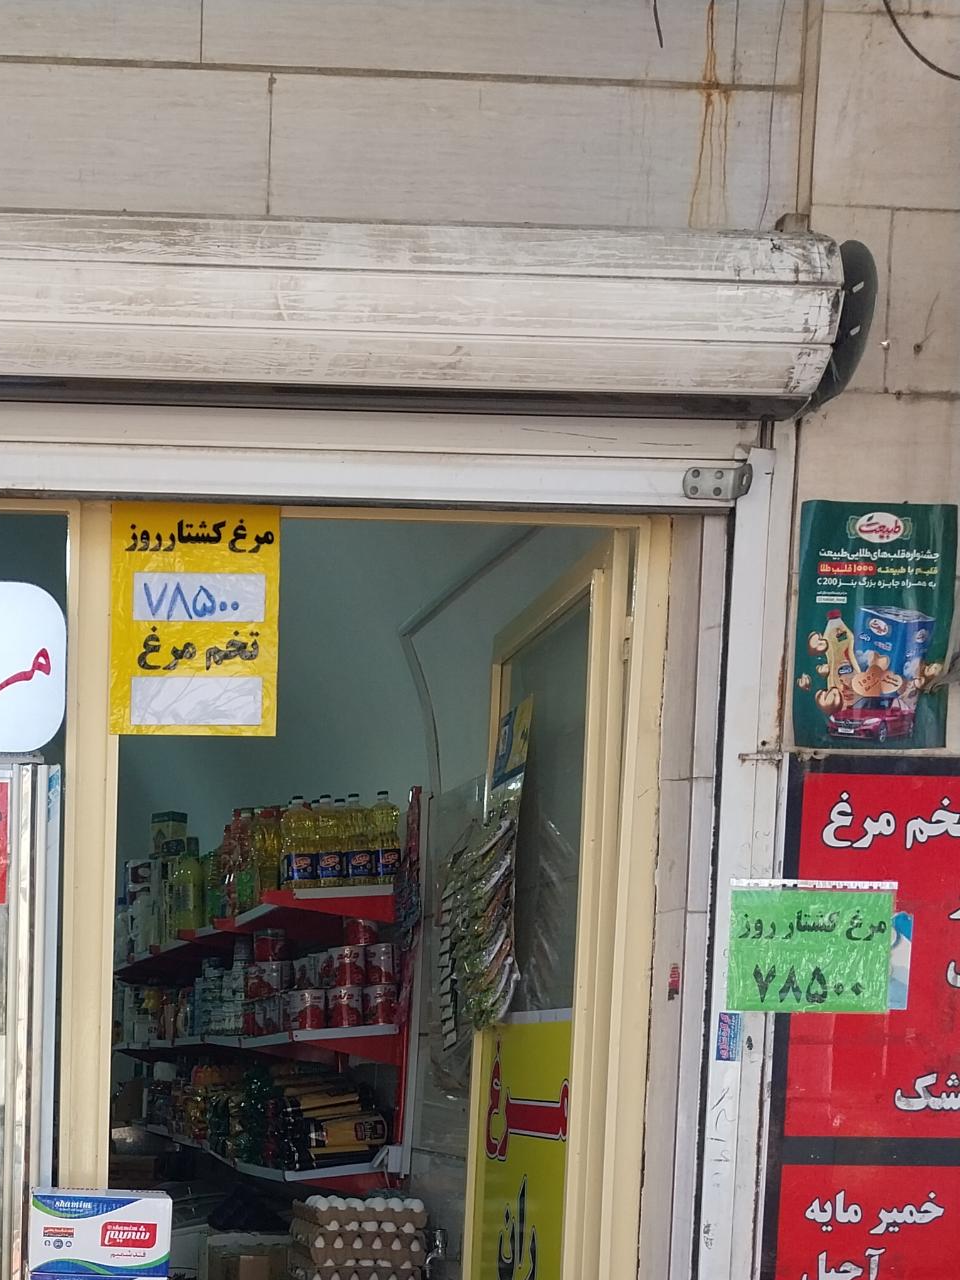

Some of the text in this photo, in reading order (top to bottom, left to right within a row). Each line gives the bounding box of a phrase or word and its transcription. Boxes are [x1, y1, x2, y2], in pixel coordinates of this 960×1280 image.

[125, 519, 274, 553] مرغ کشتار روز
[143, 582, 240, 620] ۷۸۵۰۰
[137, 626, 260, 671] تخم مرغ
[822, 791, 960, 849] خم مرغ
[738, 913, 776, 939] روز
[845, 911, 887, 941] مرغ
[752, 964, 866, 1004] ۷۸۵۰۰
[894, 1072, 960, 1111] شک
[804, 1189, 944, 1235] خمیر مایه
